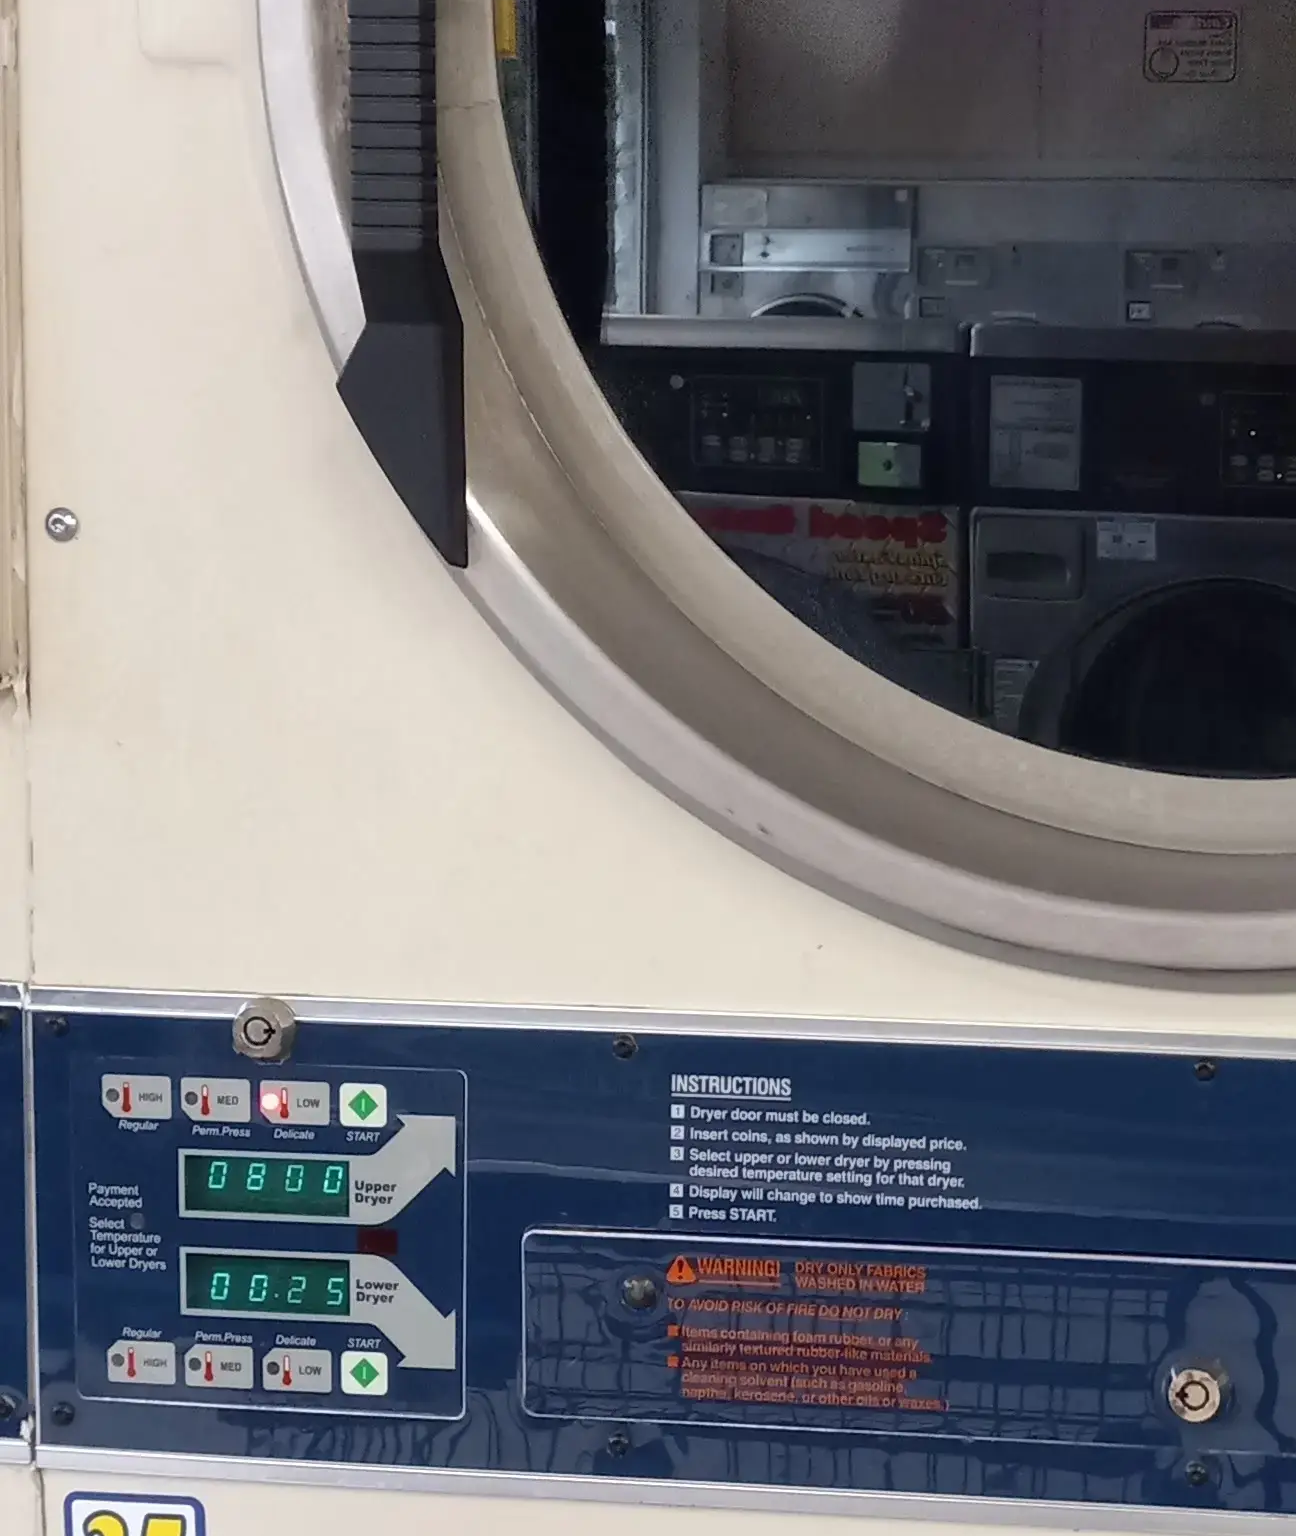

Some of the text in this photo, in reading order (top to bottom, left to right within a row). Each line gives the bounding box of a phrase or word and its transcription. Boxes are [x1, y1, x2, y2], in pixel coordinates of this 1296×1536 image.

[671, 1074, 791, 1096] INSTRUCTIONS
[138, 1093, 163, 1103] HIGH
[217, 1096, 239, 1105] MED
[297, 1098, 320, 1108] LOW
[690, 1106, 727, 1122] Dryer
[731, 1108, 761, 1121] door
[765, 1111, 799, 1123] must
[803, 1110, 819, 1123] be
[822, 1112, 871, 1126] closed.
[118, 1119, 159, 1132] Regular
[274, 1128, 315, 1140] Delicate
[346, 1131, 380, 1142] START
[690, 1128, 728, 1142] Insert
[731, 1129, 772, 1144] coins,
[775, 1133, 791, 1144] as
[795, 1132, 838, 1145] shown
[842, 1133, 859, 1149] by
[862, 1134, 926, 1151] displayed
[929, 1137, 967, 1152] price.
[689, 1148, 731, 1163] Select
[734, 1151, 774, 1167] upper
[776, 1153, 792, 1164] or
[794, 1152, 831, 1165] lower
[834, 1153, 870, 1169] dryer
[874, 1154, 889, 1171] by
[893, 1157, 951, 1173] pressing
[208, 1161, 344, 1194] 0800
[689, 1165, 965, 1190] desired temperature setting for that dryer.
[88, 1182, 139, 1196] Payment
[354, 1180, 397, 1193] Upper
[89, 1196, 142, 1209] Accepted
[354, 1193, 393, 1206] Dryer
[689, 1185, 738, 1202] Display
[741, 1186, 764, 1200] will
[767, 1188, 816, 1206] change
[819, 1189, 833, 1204] to
[836, 1190, 872, 1205] show
[875, 1193, 904, 1206] time
[908, 1194, 982, 1211] purchased.
[688, 1206, 726, 1221] Press
[729, 1207, 777, 1222] START.
[89, 1216, 125, 1229] Select
[90, 1230, 161, 1244] Temperature
[90, 1243, 158, 1257] for Upper or
[92, 1256, 166, 1272] Lower Dryers
[697, 1257, 926, 1279] WARNING! DRY ONLY FABRICS
[355, 1279, 400, 1290] Lower
[795, 1275, 855, 1291] WASHED
[875, 1280, 925, 1294] WATER
[356, 1292, 395, 1304] Dryer
[668, 1298, 685, 1310] TO
[688, 1299, 728, 1311] AVOID
[731, 1301, 763, 1313] RISK
[767, 1302, 784, 1314] OF
[787, 1304, 816, 1316] FIRE
[819, 1305, 840, 1318] DO
[843, 1306, 872, 1319] NOT
[122, 1327, 162, 1339] Regular
[682, 1326, 717, 1339] Items
[720, 1329, 789, 1344] containing
[793, 1332, 825, 1343] foam
[877, 1336, 892, 1347] or
[894, 1338, 919, 1351] any
[276, 1334, 316, 1346] Delicate
[347, 1337, 381, 1349] START
[682, 1340, 736, 1356] similarly
[739, 1342, 794, 1356] textured
[797, 1346, 867, 1361] rubber-like
[143, 1358, 167, 1368] HIGH
[220, 1361, 242, 1372] MED
[682, 1356, 708, 1371] Any
[711, 1357, 747, 1371] items
[750, 1361, 768, 1372] on
[770, 1359, 810, 1374] which
[813, 1363, 836, 1376] you
[840, 1363, 871, 1376] have
[299, 1365, 322, 1375] LOW
[682, 1371, 737, 1386] cleaning
[740, 1373, 788, 1387] solvent
[830, 1379, 847, 1391] as
[818, 1393, 855, 1406] other
